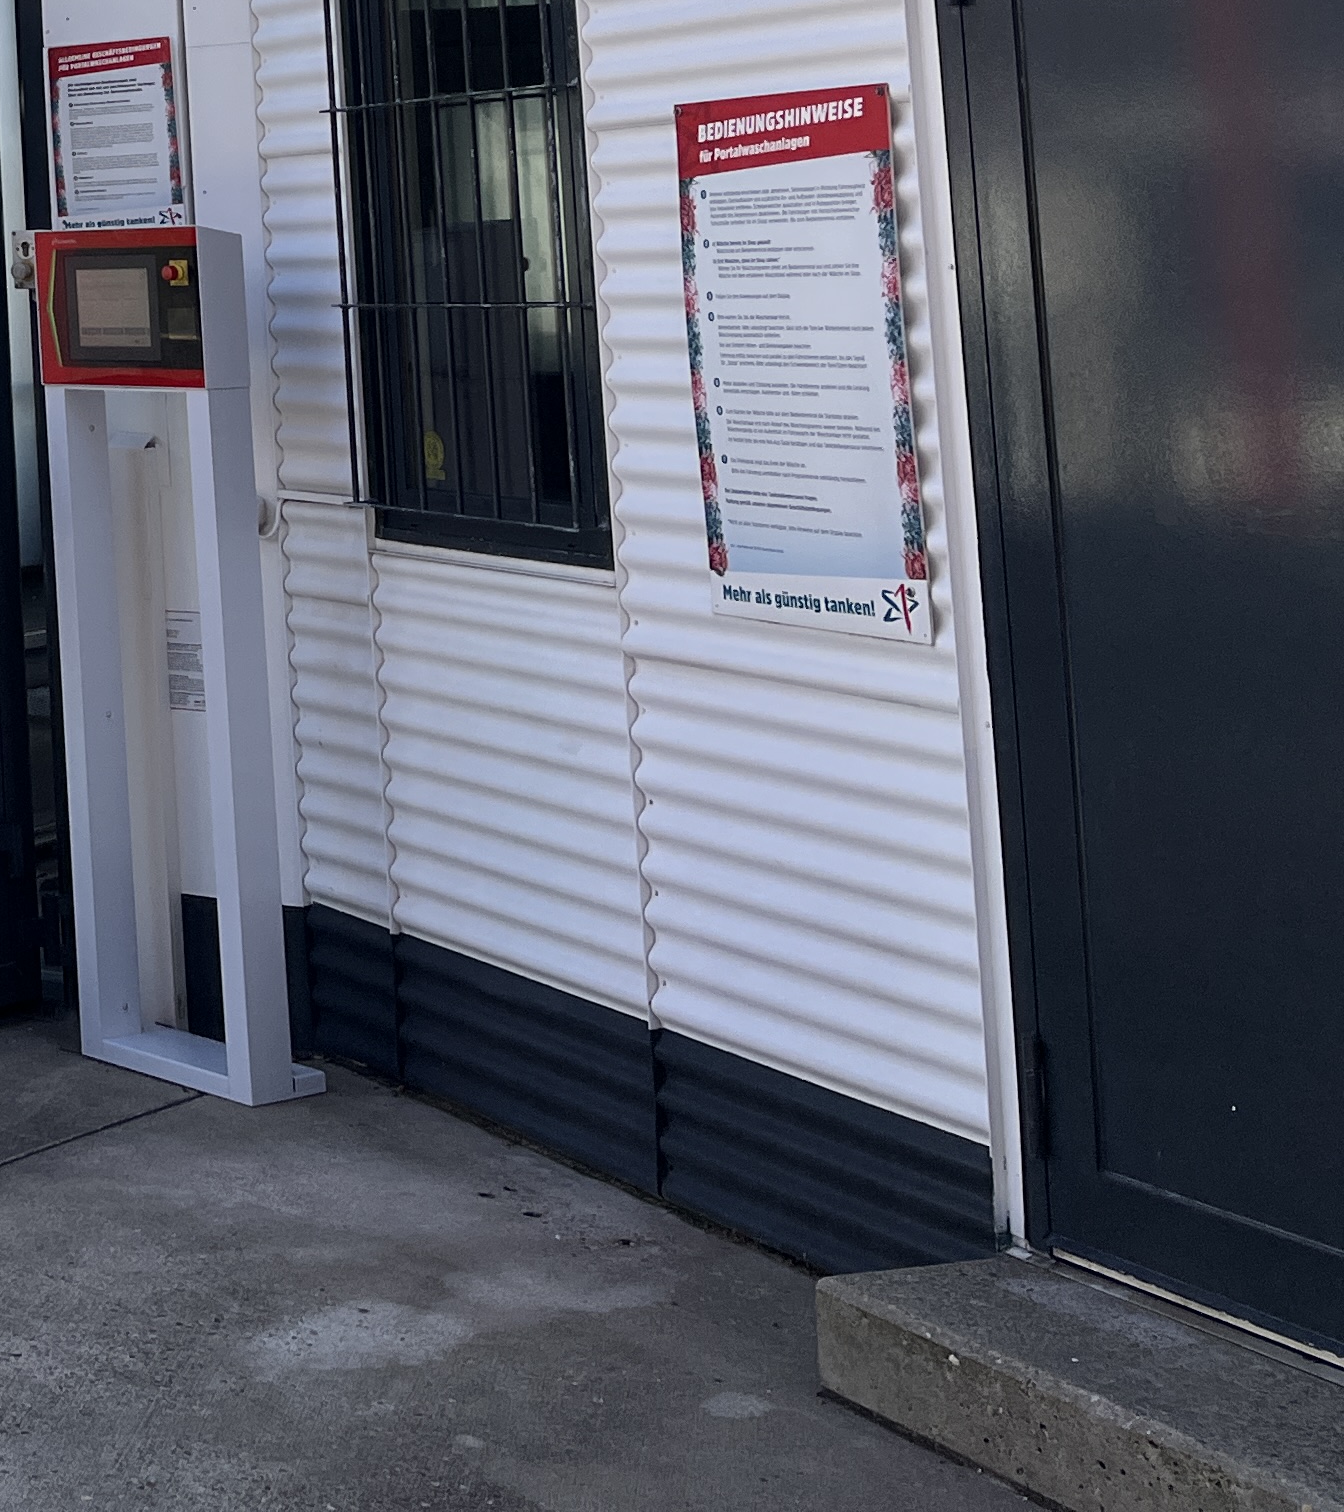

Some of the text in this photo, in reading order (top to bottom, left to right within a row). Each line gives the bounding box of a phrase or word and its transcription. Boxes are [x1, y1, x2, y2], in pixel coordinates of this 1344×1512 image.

[697, 96, 864, 144] BEDIENUNGSHINWEISE
[699, 135, 811, 165] für Portalwaschanlagen
[722, 584, 876, 617] Mehr als günstig tanken!
